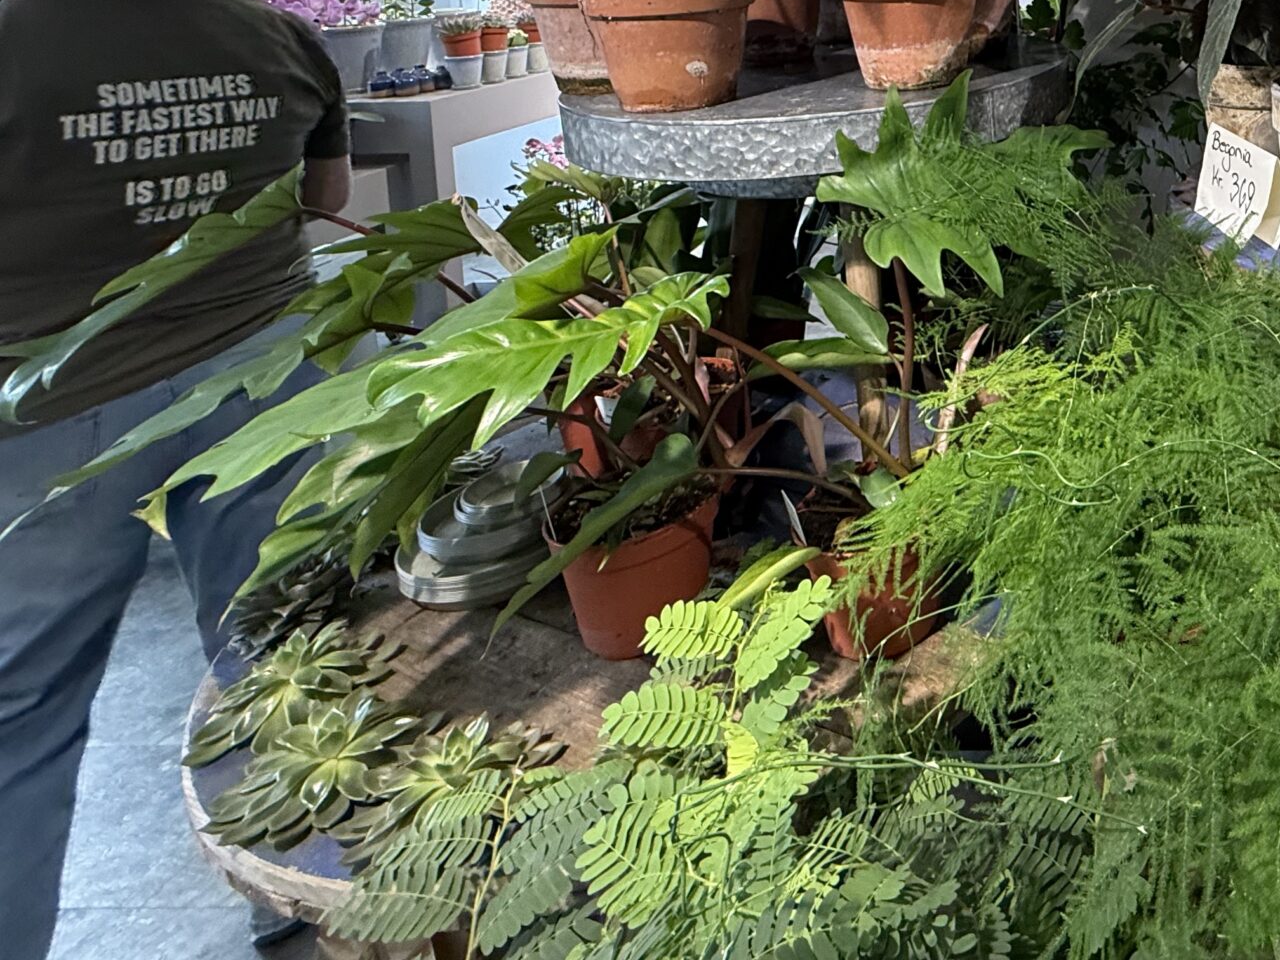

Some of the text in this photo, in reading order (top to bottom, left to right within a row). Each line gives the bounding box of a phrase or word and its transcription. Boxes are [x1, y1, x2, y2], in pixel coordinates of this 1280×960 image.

[96, 73, 253, 109] SOMETIMES
[60, 96, 280, 140] THE FASTEST WAY
[92, 123, 260, 164] TO GET THERE
[1211, 130, 1253, 173] Begonia
[125, 169, 228, 206] IS TO GO
[135, 196, 217, 224] SLOW
